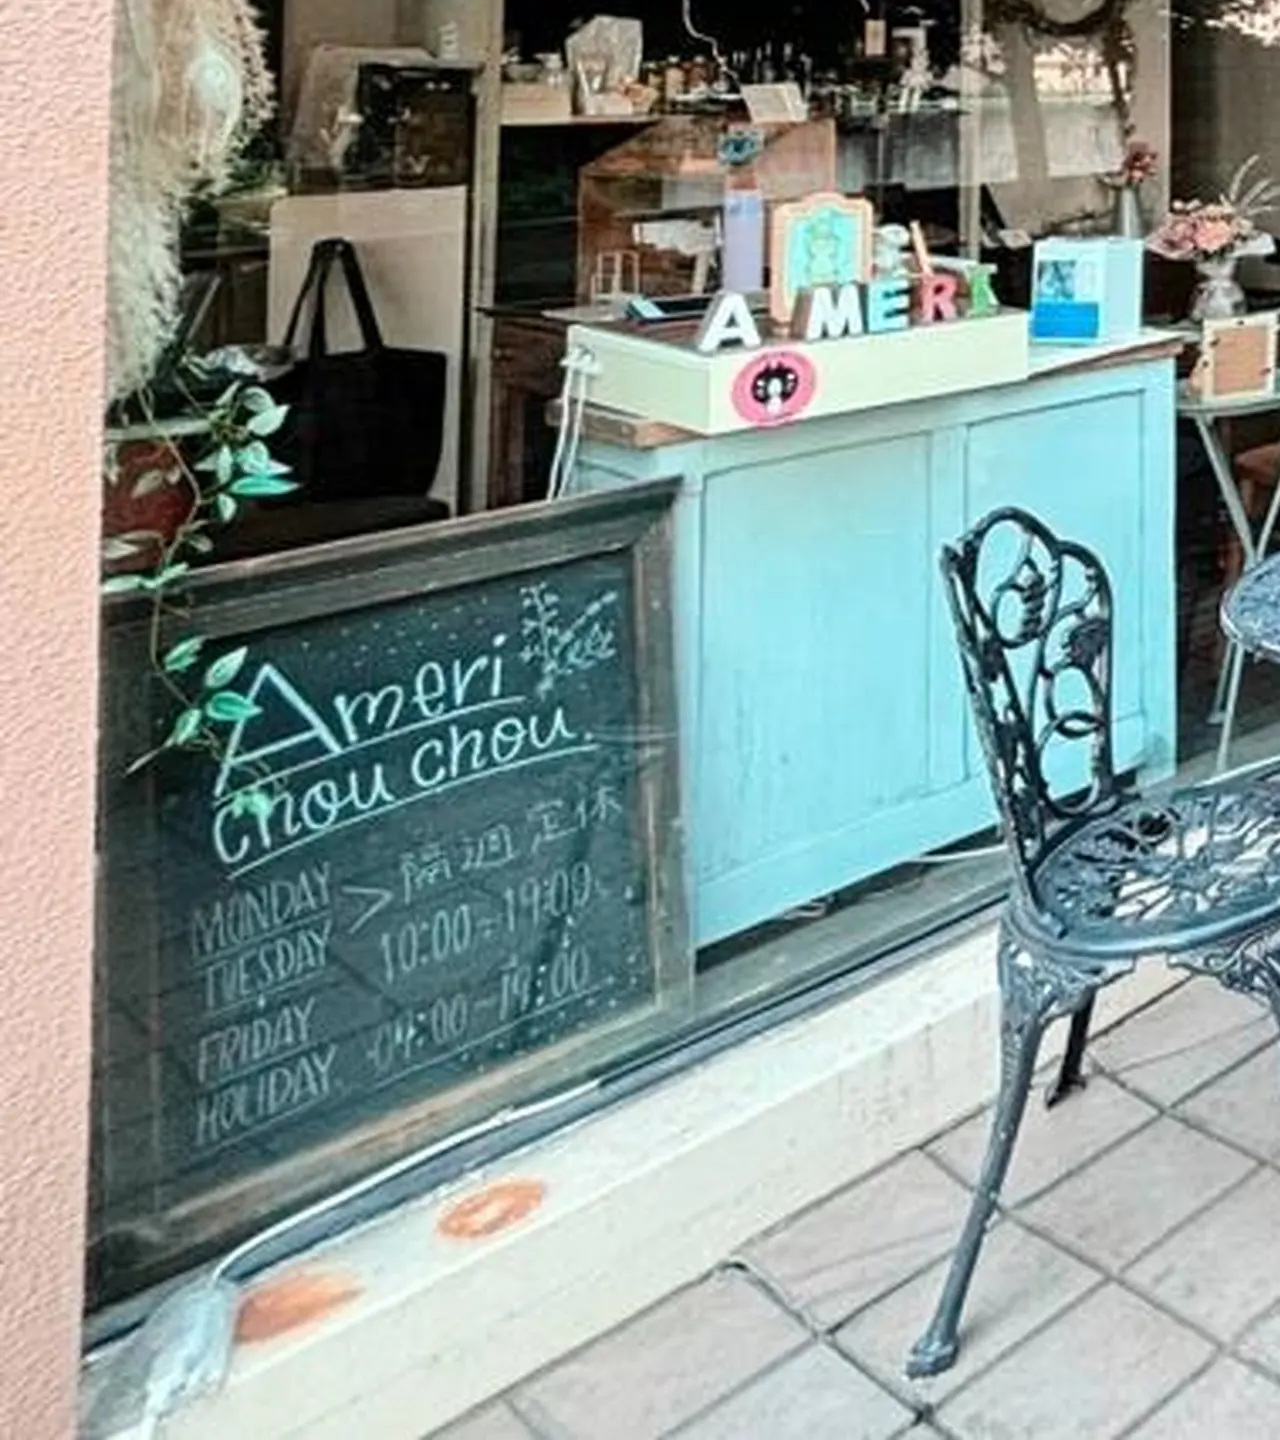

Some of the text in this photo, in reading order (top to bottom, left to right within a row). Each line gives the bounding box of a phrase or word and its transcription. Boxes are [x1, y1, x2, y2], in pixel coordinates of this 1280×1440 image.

[215, 633, 508, 798] Ameri
[213, 763, 396, 863] chou
[190, 860, 332, 956] MONDAY
[203, 918, 333, 1009] TUESDAY
[197, 996, 316, 1083] FRIDAY
[196, 1044, 338, 1146] HOLIDAY
